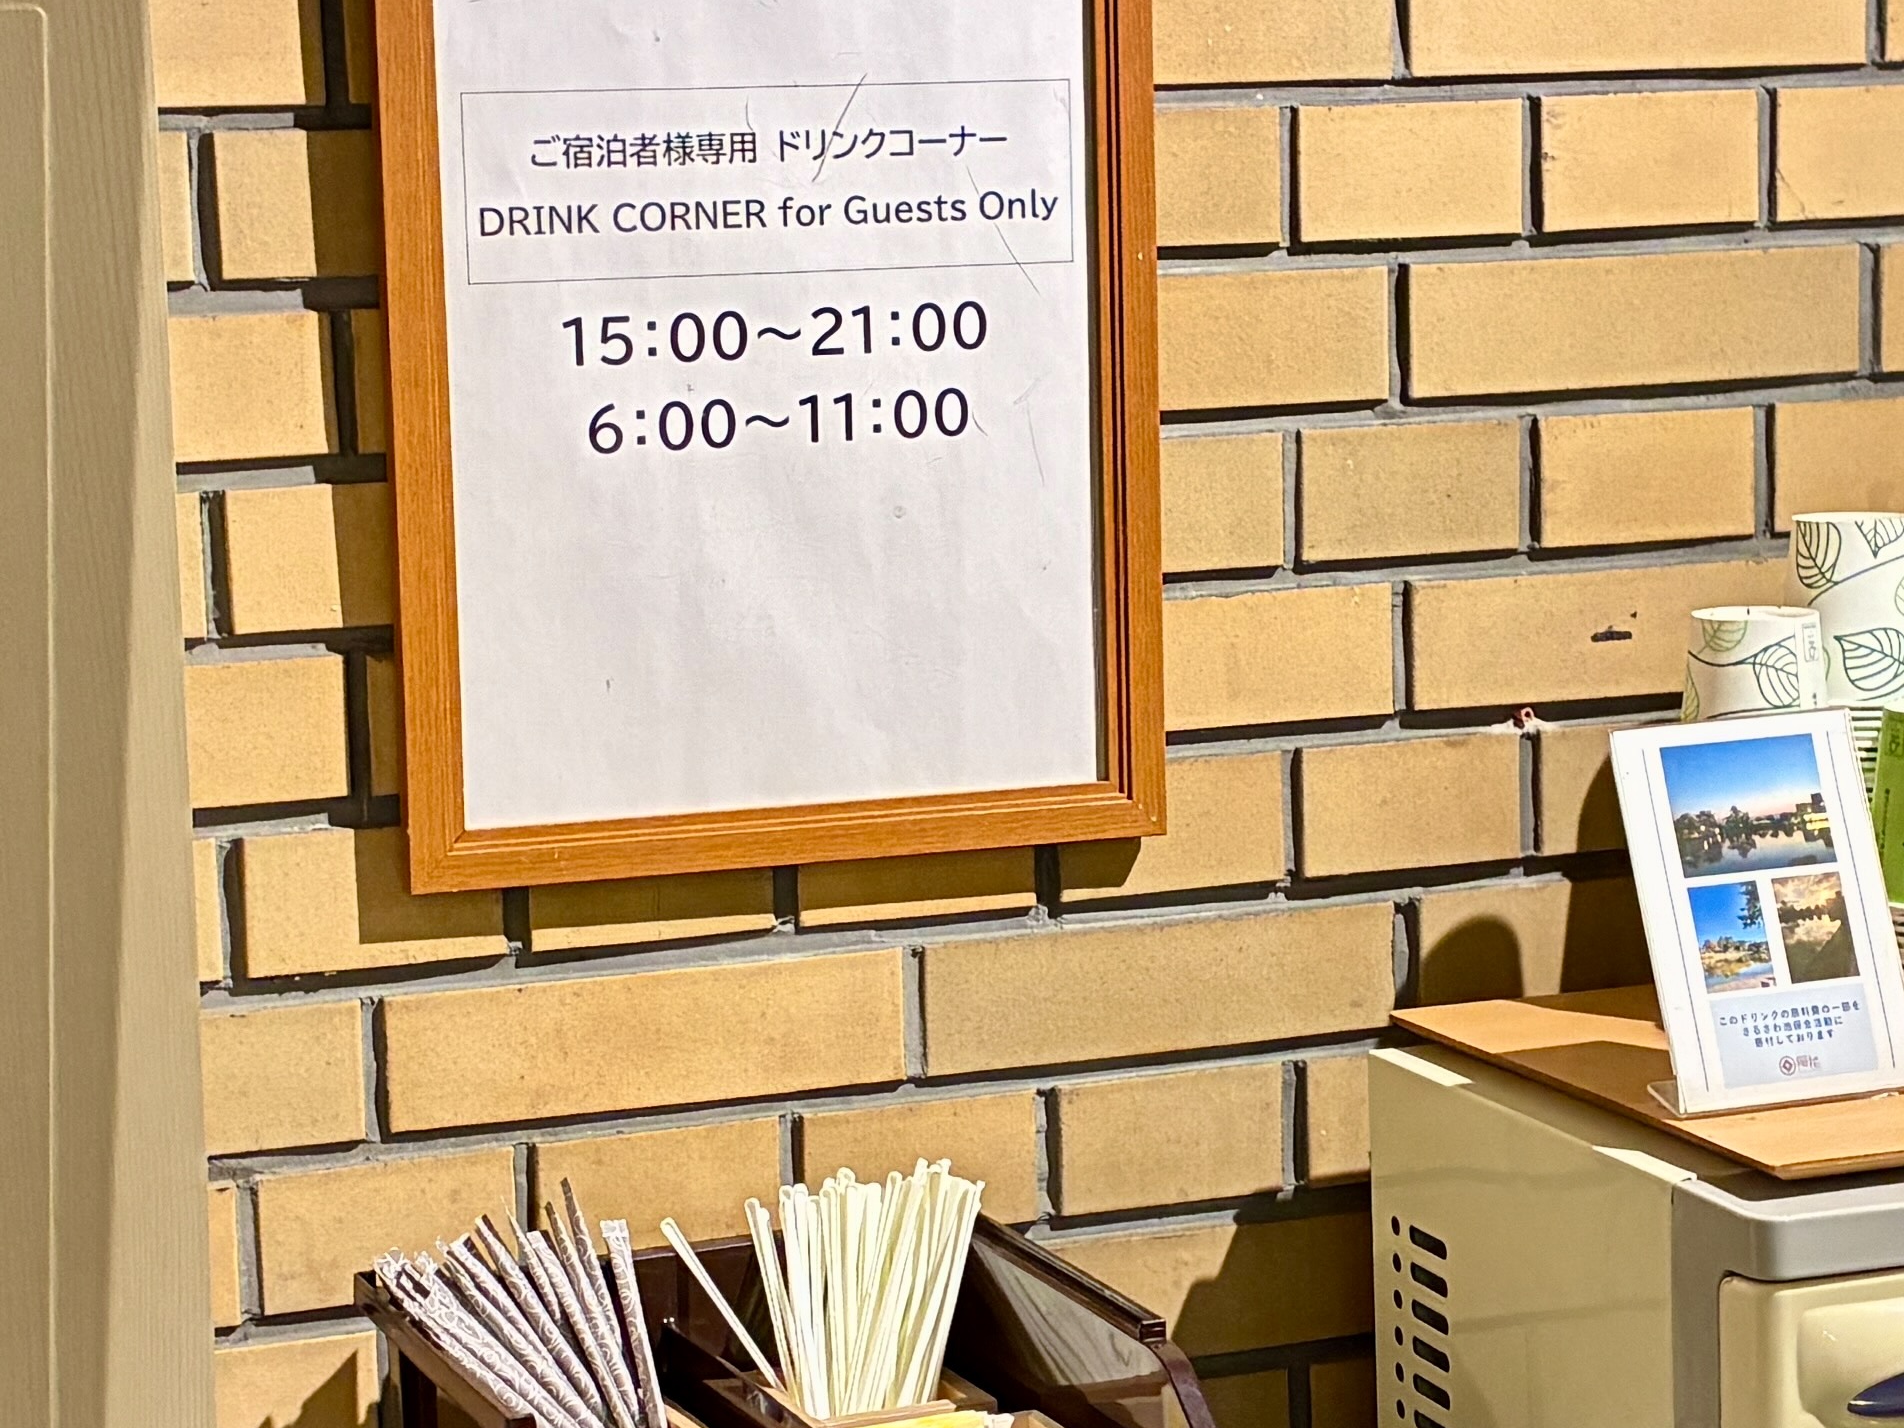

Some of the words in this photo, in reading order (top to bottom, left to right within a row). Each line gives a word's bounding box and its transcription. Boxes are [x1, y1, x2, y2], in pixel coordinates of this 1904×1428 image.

[530, 131, 757, 170] ご宿泊者様専用
[778, 125, 1008, 164] ドリンクコーナー
[479, 203, 600, 237] DRINK
[612, 198, 766, 233] CORNER
[778, 196, 832, 228] for
[843, 191, 967, 226] Guests
[979, 188, 1059, 226] Only
